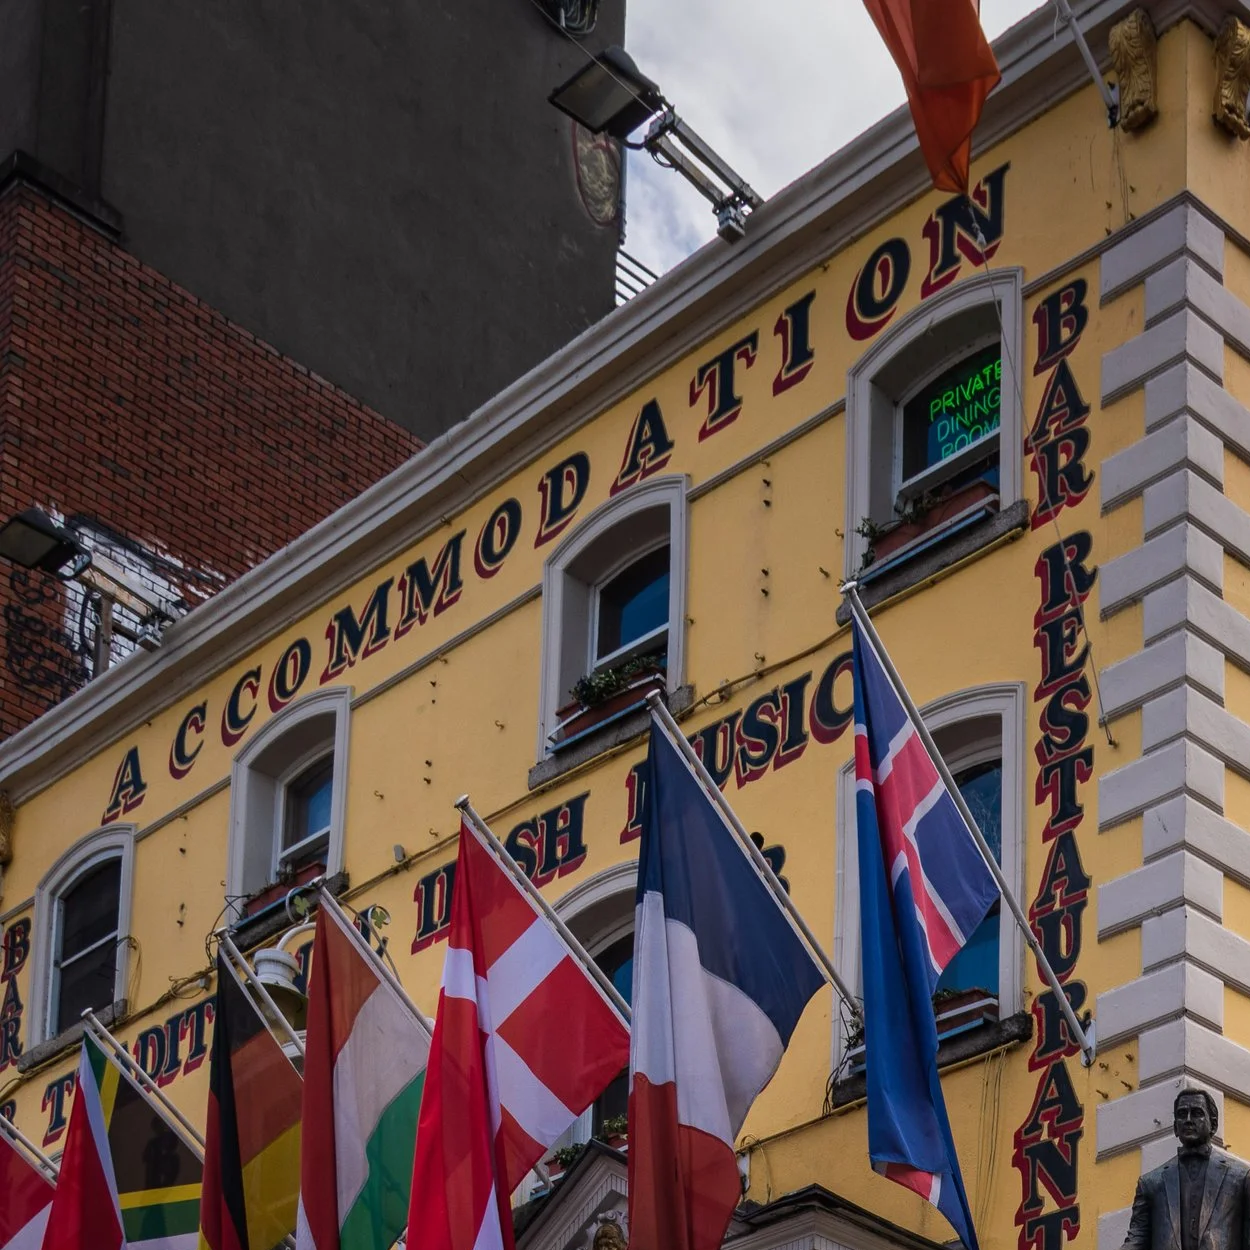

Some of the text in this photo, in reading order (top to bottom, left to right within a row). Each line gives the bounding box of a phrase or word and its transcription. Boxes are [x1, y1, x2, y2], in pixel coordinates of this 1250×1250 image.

[928, 358, 1001, 423] PRIVATE
[936, 386, 1001, 444] DINING
[1023, 276, 1096, 532] BAR
[106, 160, 1012, 826] ACCOMMODATION
[411, 789, 592, 956] ISH
